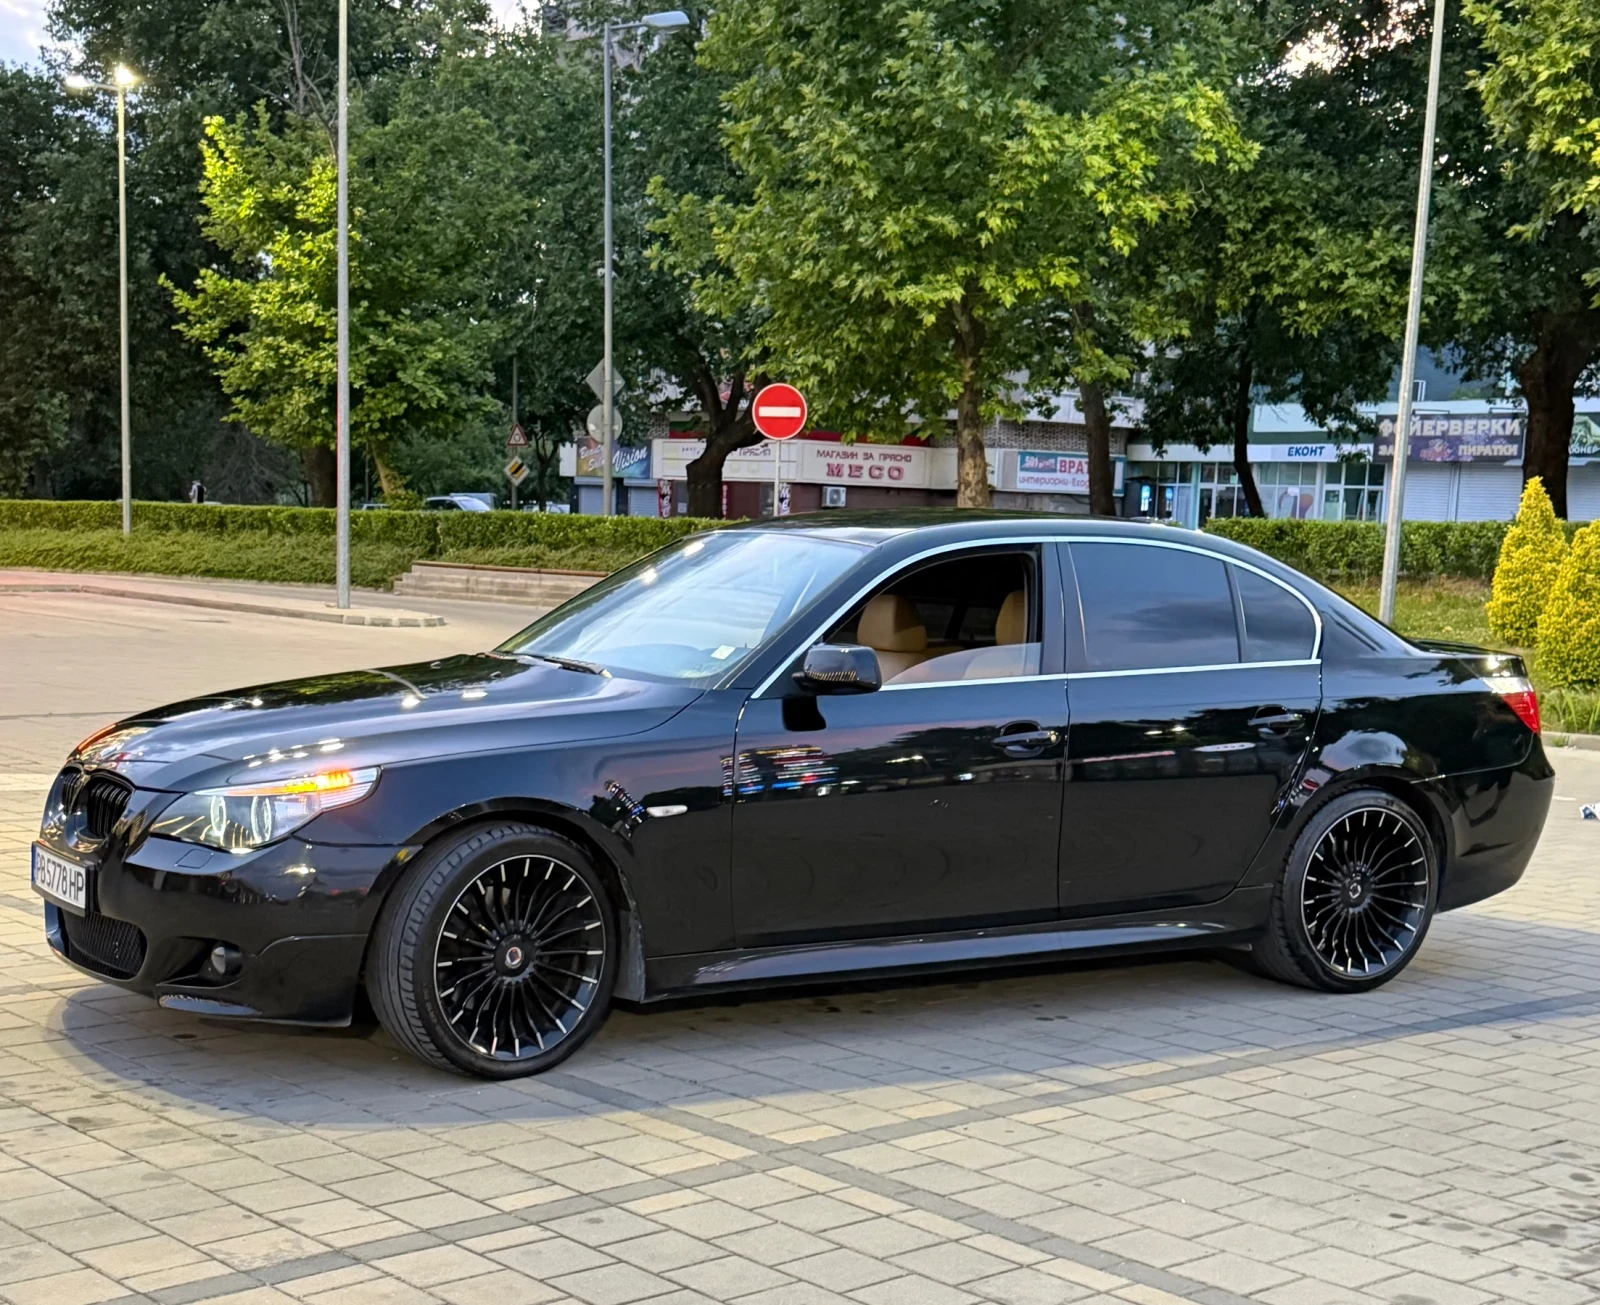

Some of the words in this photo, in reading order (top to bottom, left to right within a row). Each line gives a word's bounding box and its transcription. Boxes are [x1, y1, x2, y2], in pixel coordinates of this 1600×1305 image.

[816, 449, 858, 460] МАГАЗИН
[862, 452, 875, 461] ЗА
[879, 453, 912, 463] ПРЯСНО
[1287, 446, 1326, 457] ЕКОНТ
[1457, 444, 1519, 456] ПИРАТКИ
[612, 446, 648, 472] Vision
[826, 463, 904, 480] МЕСО
